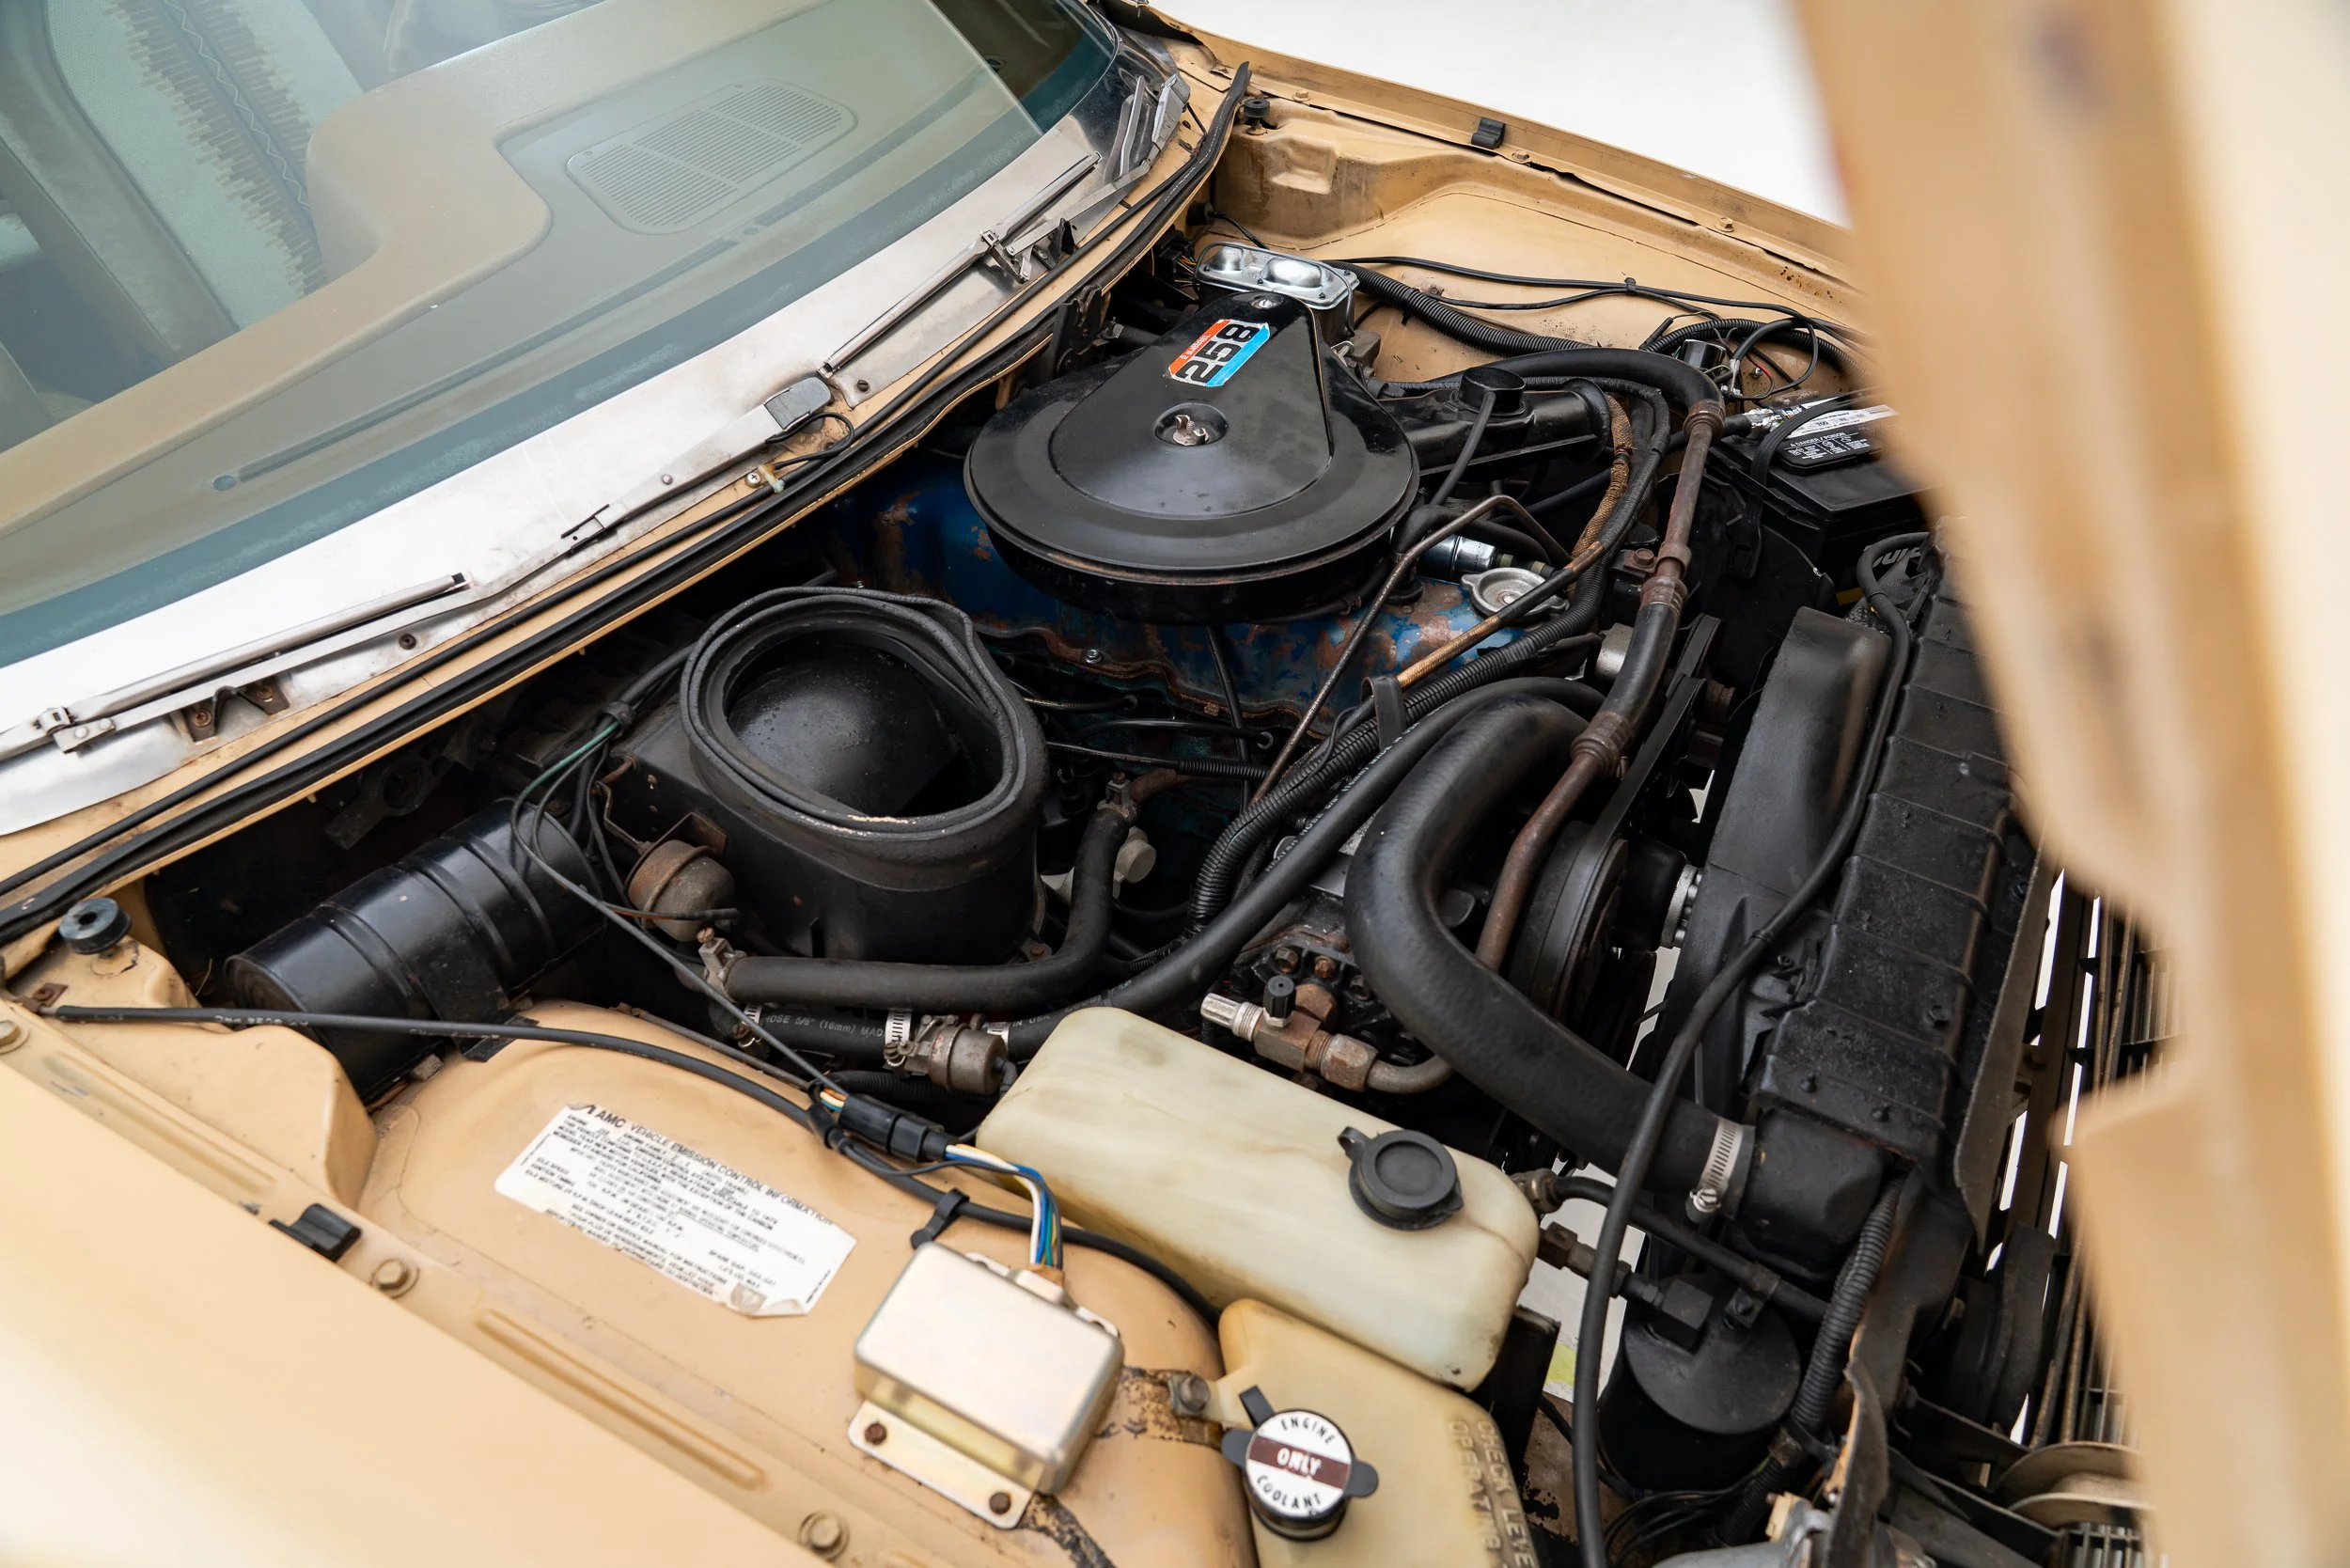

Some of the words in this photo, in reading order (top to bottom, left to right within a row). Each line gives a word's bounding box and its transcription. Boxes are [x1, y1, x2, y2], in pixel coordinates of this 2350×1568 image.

[1175, 323, 1261, 384] 258
[819, 1019, 856, 1034] (16mm)
[859, 1027, 885, 1038] MAD
[593, 1108, 627, 1129] AMC
[628, 1122, 671, 1147] VEHICLE
[669, 1141, 718, 1169] EMISSION
[715, 1164, 765, 1192] CONTROL
[763, 1186, 836, 1226] INFORMATION
[1280, 1416, 1336, 1446] ENGINE
[1277, 1447, 1323, 1477] ONLY
[1257, 1474, 1322, 1510] COOLANT
[1477, 1419, 1512, 1494] CHECK
[1502, 1507, 1536, 1568] LEVE
